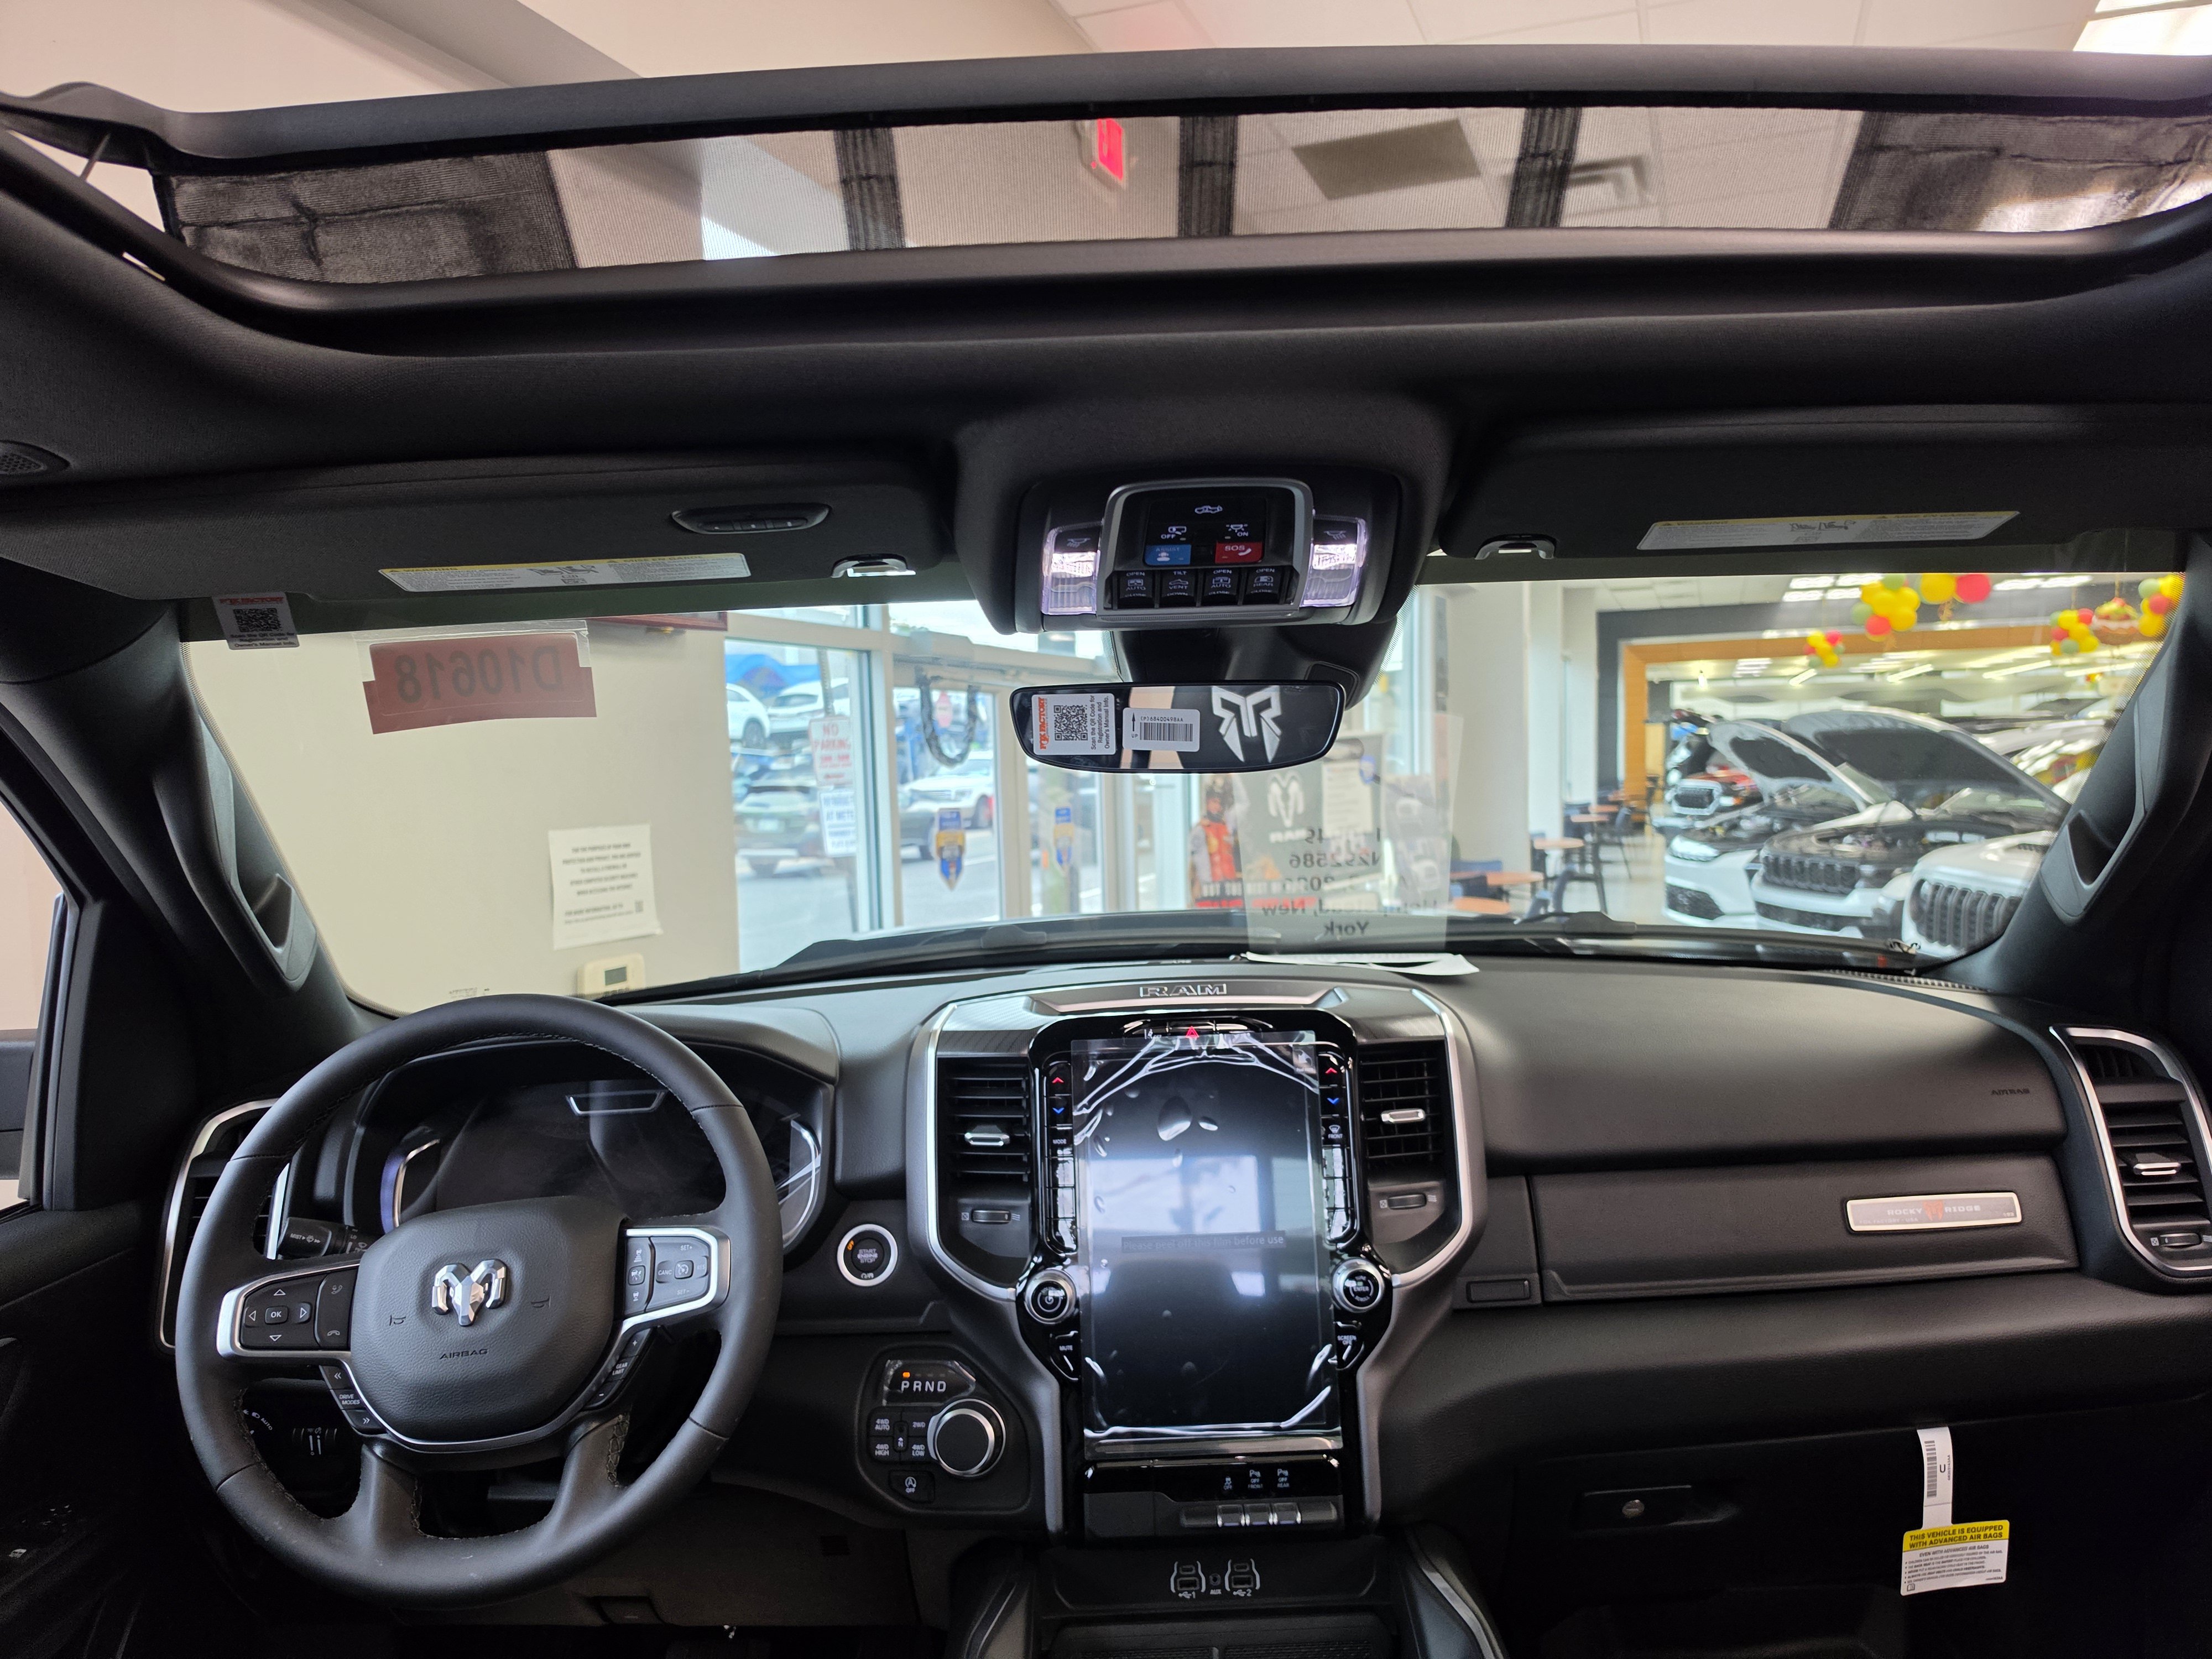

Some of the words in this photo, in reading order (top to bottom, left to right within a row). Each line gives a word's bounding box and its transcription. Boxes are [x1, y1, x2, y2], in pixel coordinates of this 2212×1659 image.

[1038, 697, 1046, 733] FACTORY
[1090, 718, 1097, 726] QR
[1140, 984, 1227, 997] RAM
[1887, 1208, 1923, 1216] ROCKY
[1944, 1204, 1981, 1213] RIDGE
[1123, 1241, 1152, 1250] Please
[1155, 1240, 1174, 1251] peel
[1194, 1238, 1211, 1247] this
[1212, 1237, 1232, 1247] film
[1234, 1235, 1265, 1245] before
[1267, 1235, 1284, 1244] use
[440, 1349, 488, 1359] AIRBAG
[260, 1417, 273, 1431] AUTO
[1910, 1532, 1926, 1541] THIS
[1927, 1529, 1957, 1538] VEHICLE
[1966, 1525, 2004, 1533] EQUIPPED
[1909, 1540, 1927, 1549] WITH
[1929, 1536, 1968, 1546] ADVANCED
